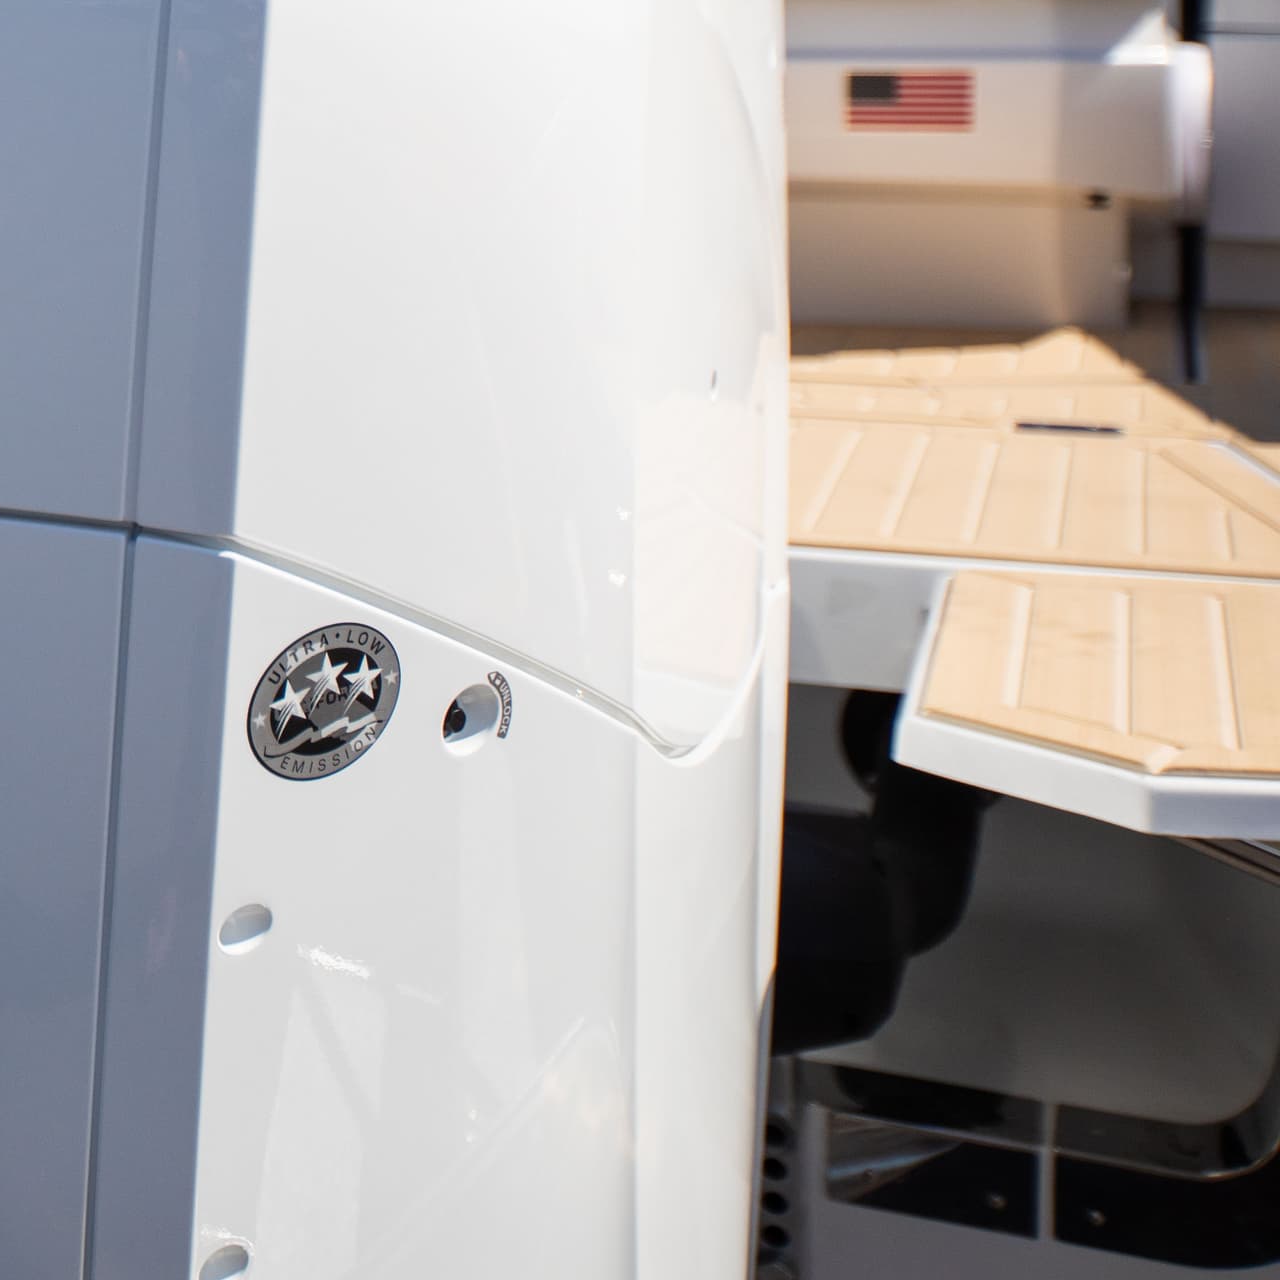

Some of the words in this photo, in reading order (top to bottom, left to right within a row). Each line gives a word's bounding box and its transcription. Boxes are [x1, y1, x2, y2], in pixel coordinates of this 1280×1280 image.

[268, 633, 329, 685] ULTRA
[346, 629, 386, 656] LOW
[498, 682, 512, 735] UNLOCK
[280, 726, 377, 774] EMISSION
